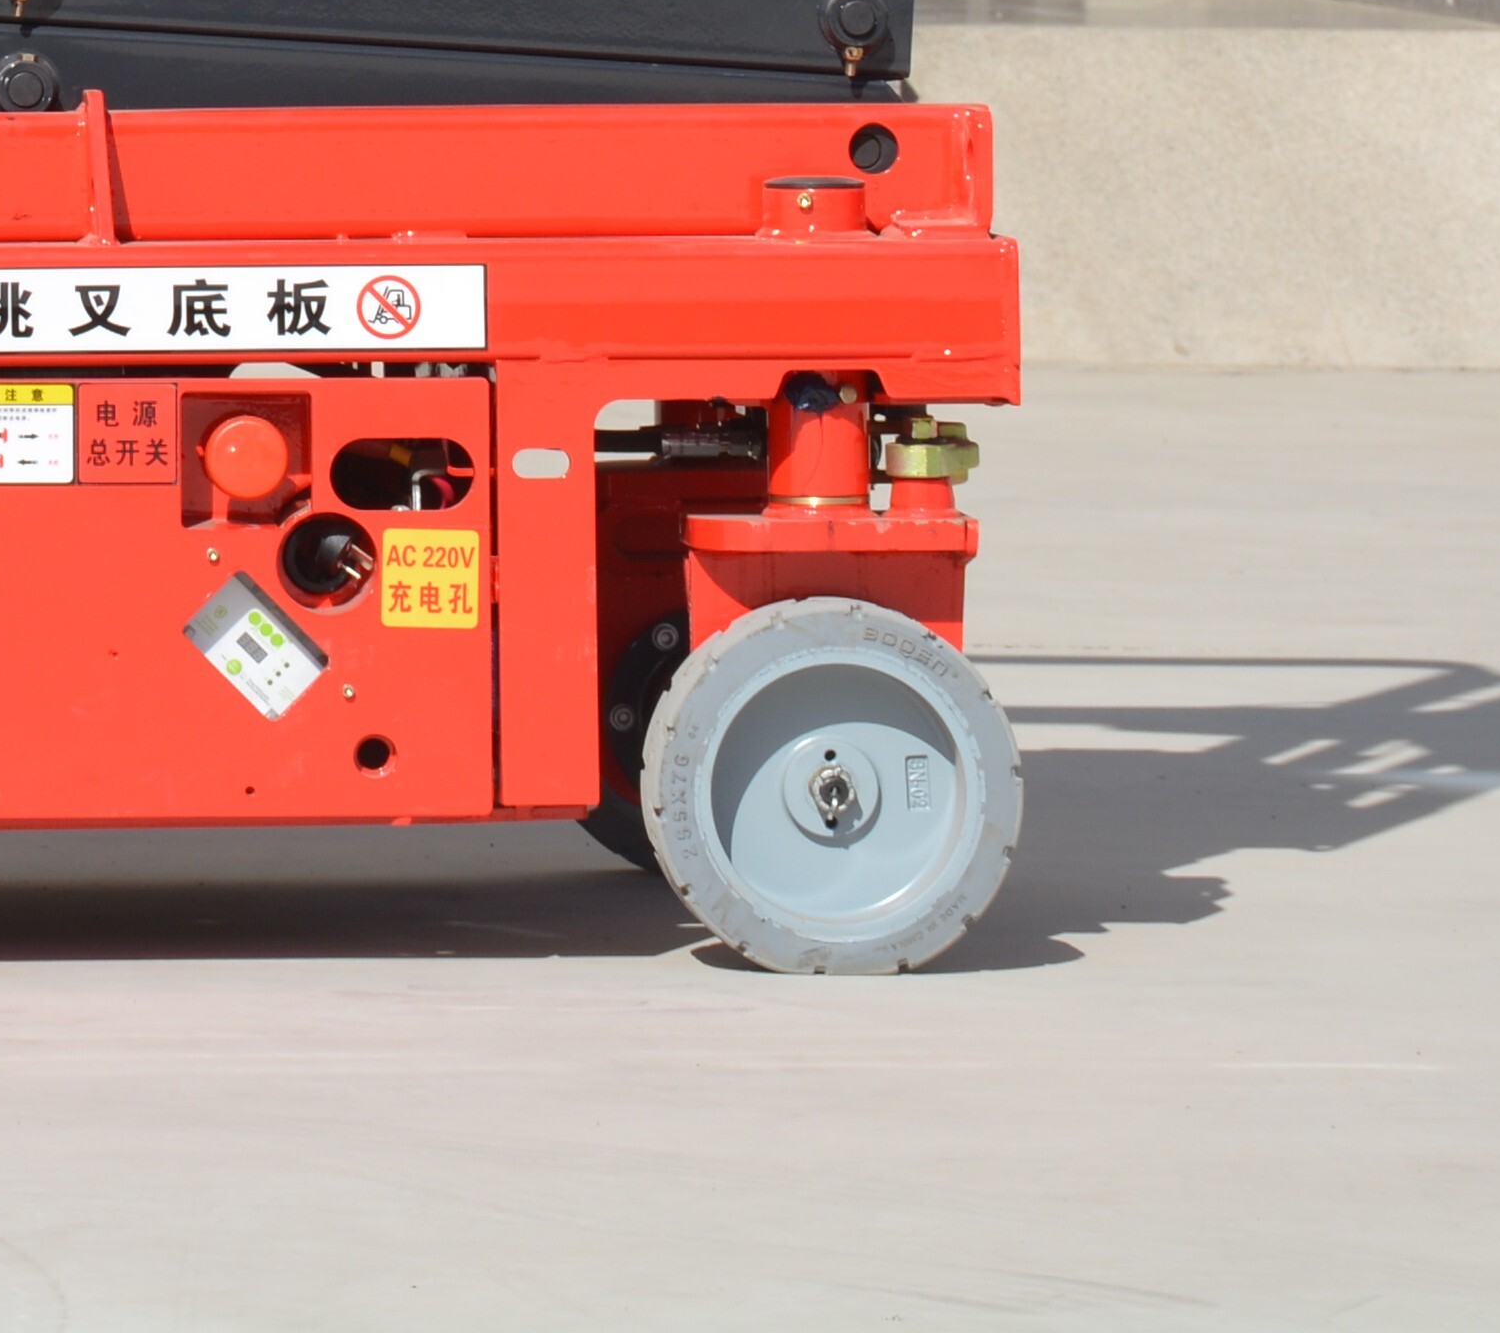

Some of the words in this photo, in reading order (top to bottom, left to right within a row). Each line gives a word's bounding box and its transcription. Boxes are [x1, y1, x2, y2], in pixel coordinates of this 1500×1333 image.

[5, 389, 44, 402] 注意
[96, 400, 157, 427] 电源
[87, 439, 168, 466] 总开关
[387, 545, 416, 567] AC
[422, 546, 475, 568] 220V
[388, 581, 473, 614] 充电孔
